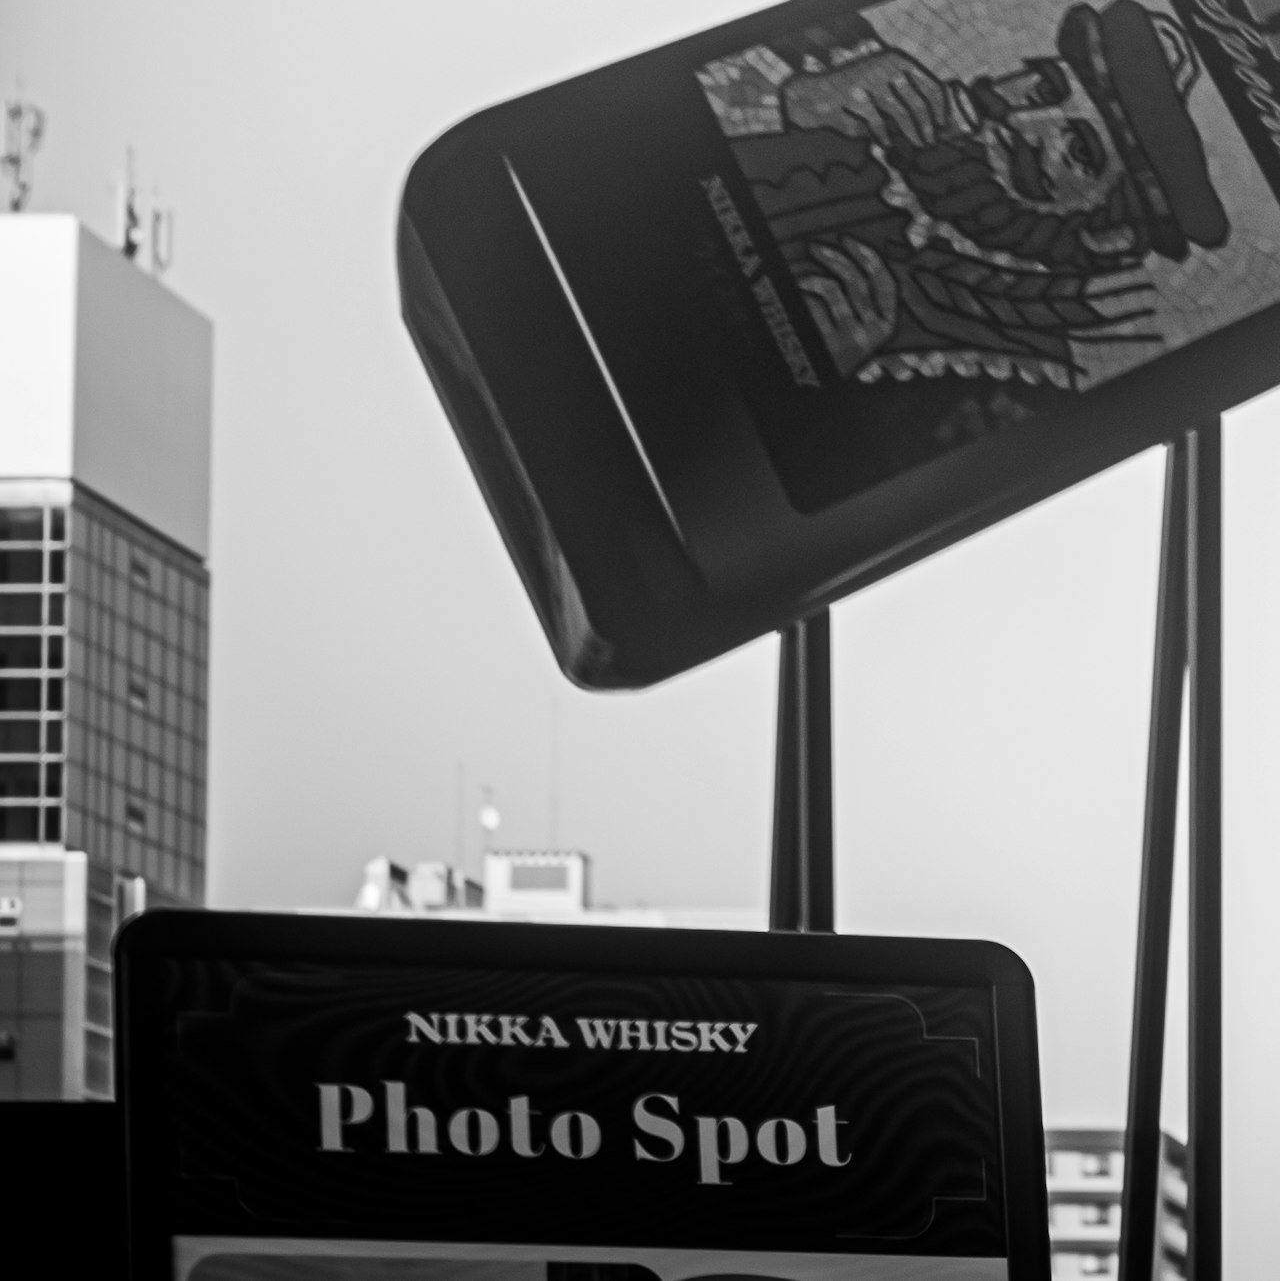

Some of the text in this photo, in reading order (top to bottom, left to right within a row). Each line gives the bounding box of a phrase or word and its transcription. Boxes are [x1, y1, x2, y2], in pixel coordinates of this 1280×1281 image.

[698, 175, 764, 279] NIKKA
[750, 273, 822, 389] WHISKY
[403, 1010, 760, 1056] NIKKA WHISKY
[314, 1079, 854, 1186] Photo Spot
